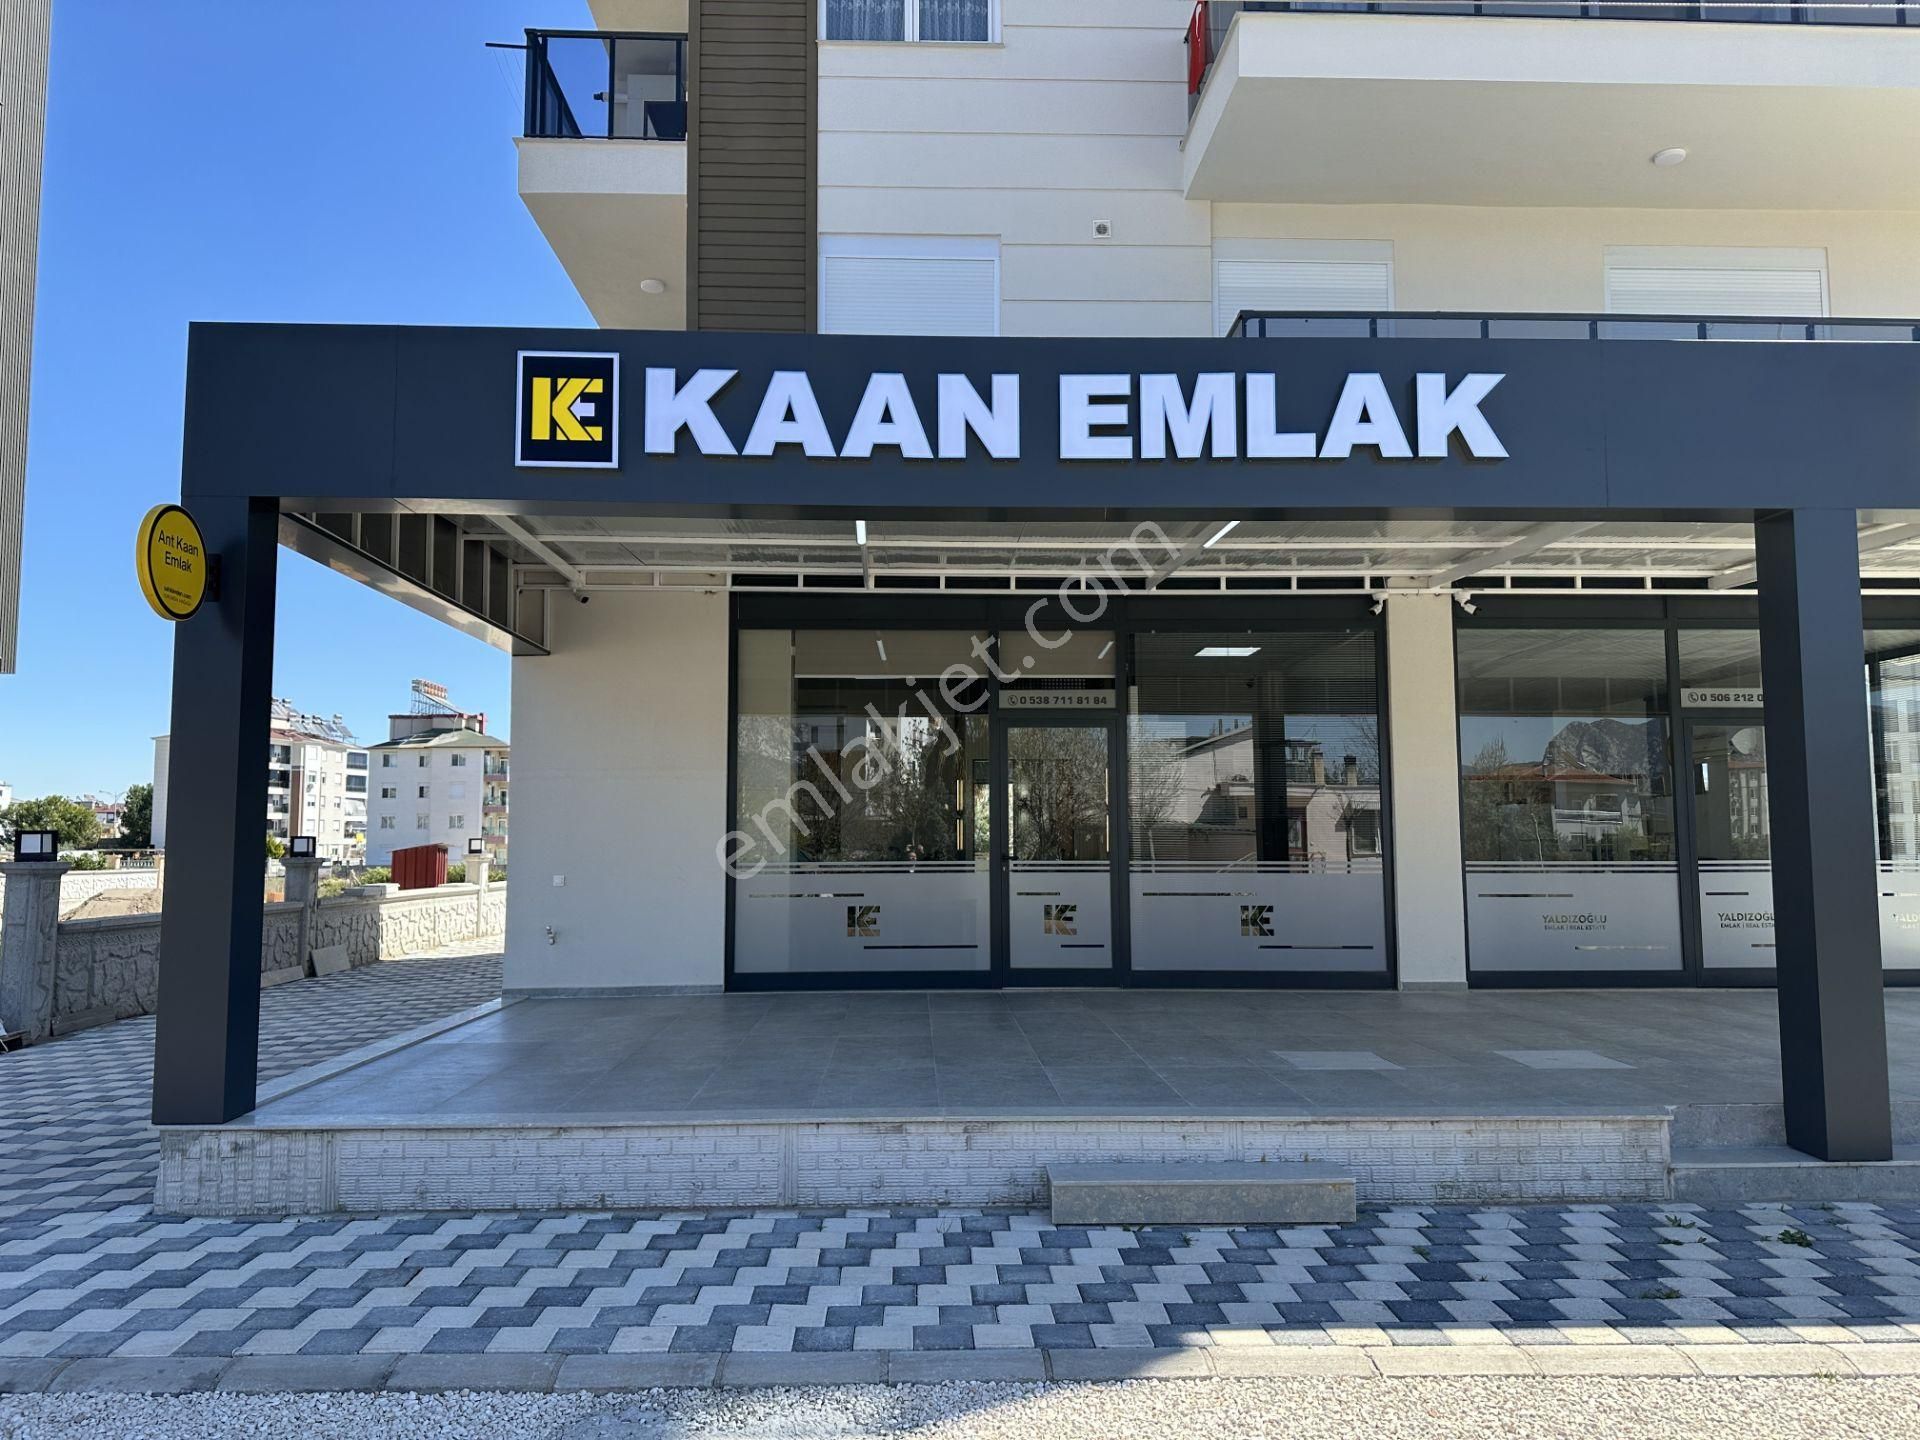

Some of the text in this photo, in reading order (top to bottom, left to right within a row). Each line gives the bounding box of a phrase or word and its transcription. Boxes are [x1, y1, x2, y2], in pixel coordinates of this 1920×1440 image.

[644, 366, 1511, 460] KAAN EMLAK
[158, 529, 199, 557] Ant Kaan
[165, 551, 192, 573] Emlak
[1020, 696, 1027, 705] 0
[1029, 696, 1050, 705] 538
[1053, 696, 1073, 705] 711
[1076, 696, 1090, 705] 81
[1700, 693, 1707, 702] 0
[1710, 693, 1731, 702] 506
[1734, 693, 1754, 702] 212
[1718, 911, 1774, 922] YALDIZOĞL
